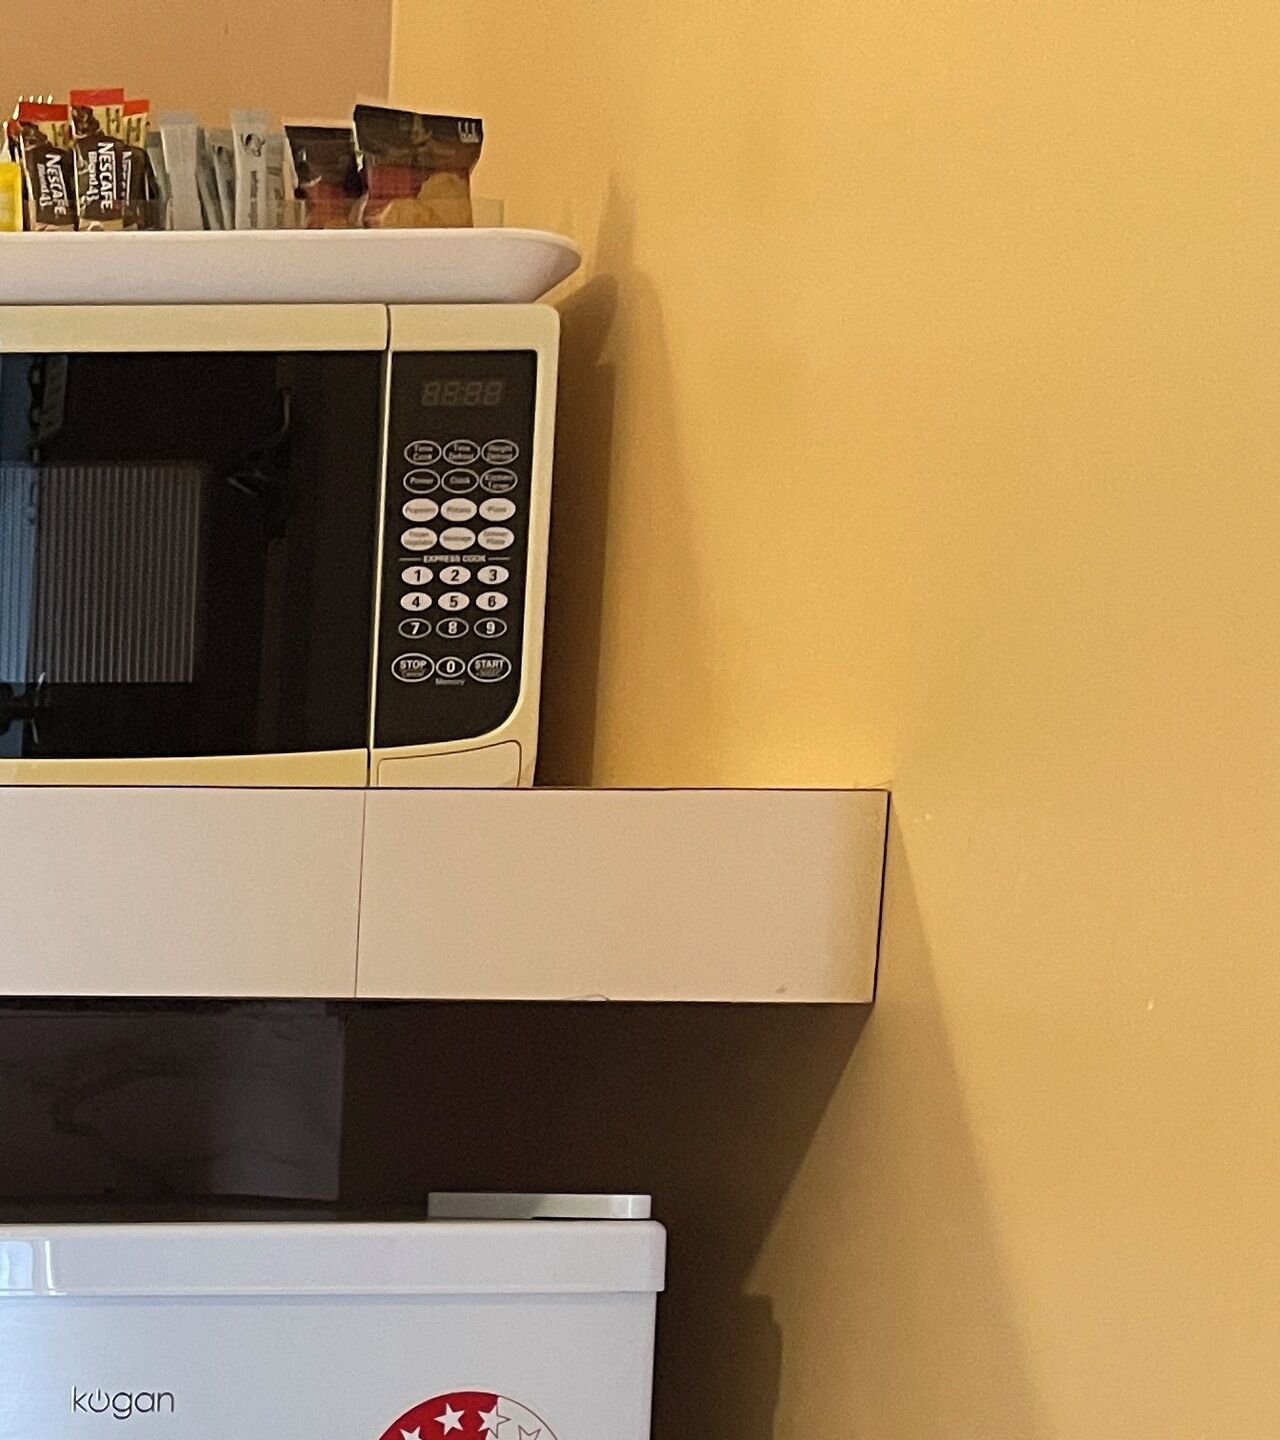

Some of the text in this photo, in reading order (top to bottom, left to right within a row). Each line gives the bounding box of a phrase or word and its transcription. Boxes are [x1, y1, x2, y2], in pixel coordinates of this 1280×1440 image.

[423, 555, 461, 563] EXPRESS
[414, 569, 421, 582] 1
[451, 569, 460, 582] 2
[489, 569, 497, 581] 3
[412, 596, 420, 608] 4
[449, 595, 458, 608] 5
[488, 595, 496, 608] 6
[410, 622, 420, 634] 7
[448, 621, 457, 634] 8
[486, 621, 495, 634] 9
[399, 660, 427, 669] STOP
[446, 661, 455, 673] 0
[474, 659, 505, 669] START
[72, 1386, 175, 1420] kogan
